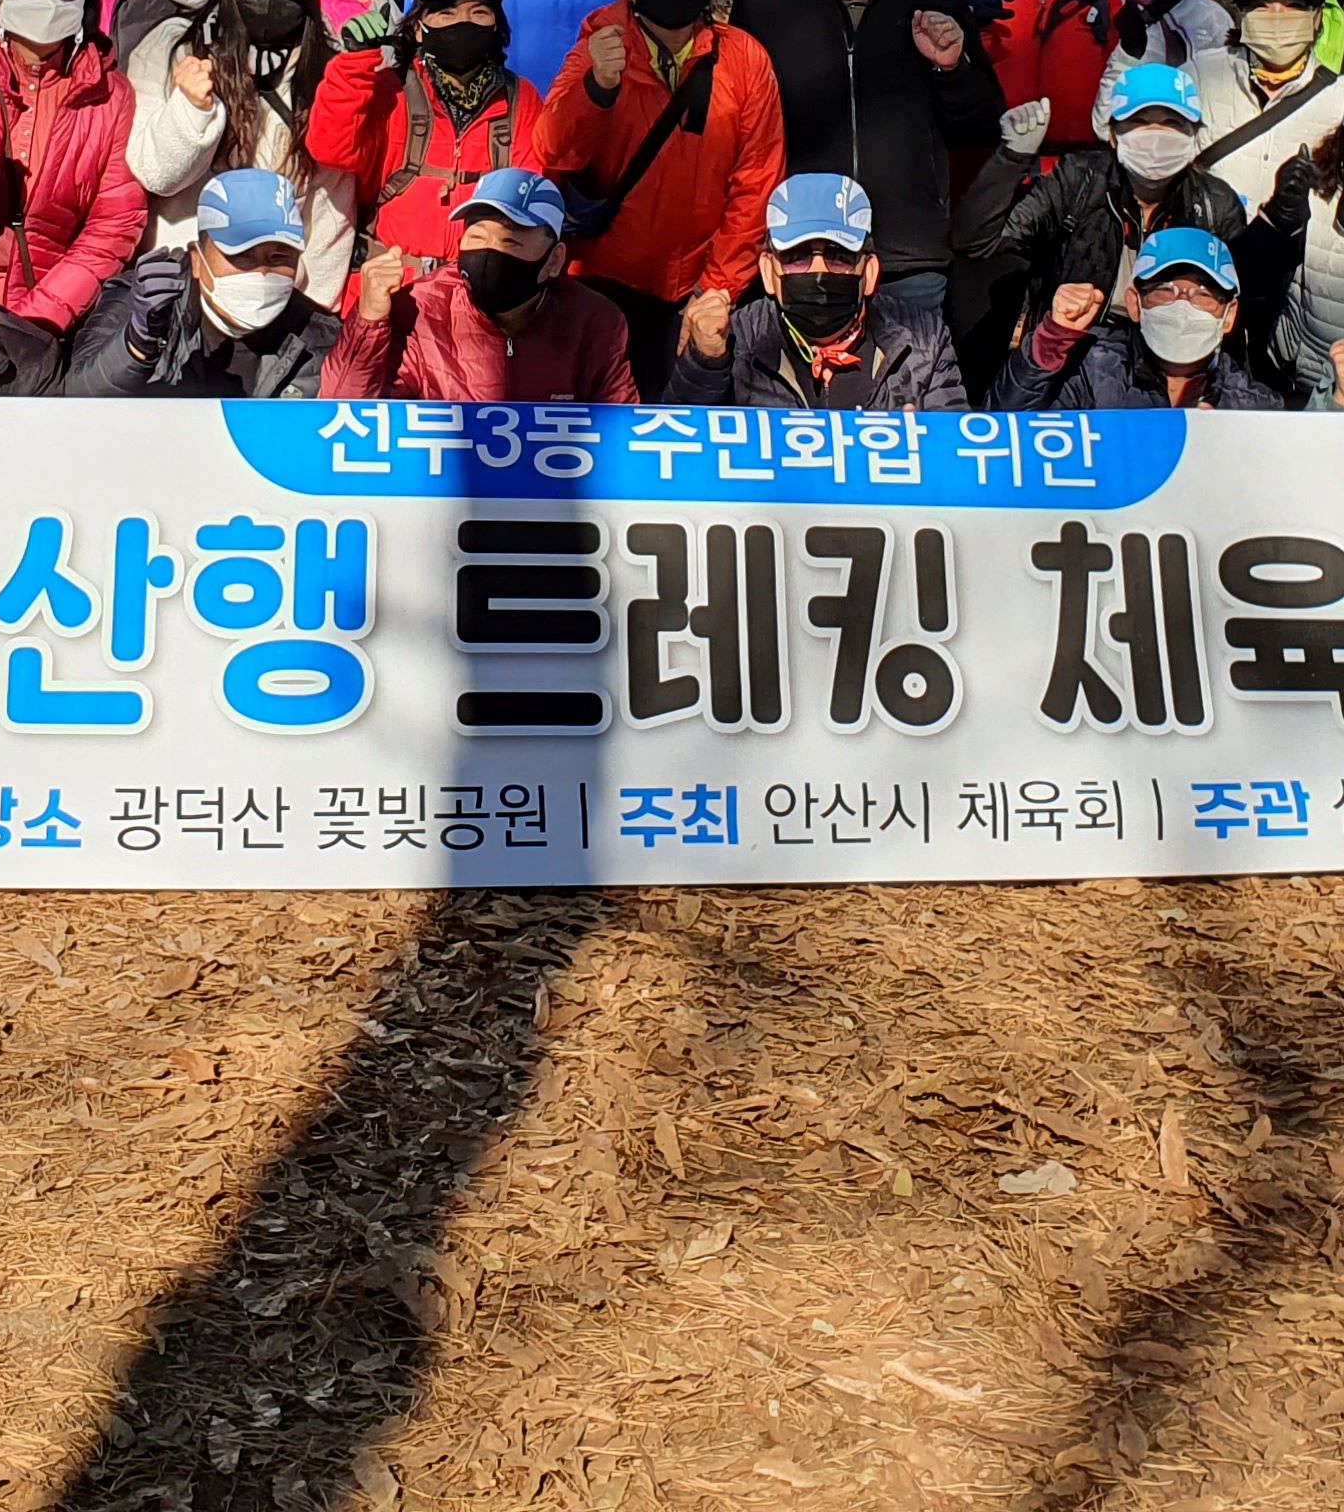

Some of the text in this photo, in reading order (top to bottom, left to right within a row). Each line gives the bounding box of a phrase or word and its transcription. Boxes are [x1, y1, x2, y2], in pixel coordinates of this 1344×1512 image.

[317, 402, 1102, 488] 선부3동 주민화합 위한
[456, 519, 956, 728] 트레킹
[109, 785, 291, 851] 광덕산
[313, 783, 548, 851] 꽃빛공원
[619, 783, 740, 849] 주최
[764, 780, 931, 845] 안산시
[957, 779, 1125, 843] 체육회
[1190, 778, 1311, 840] 주관
